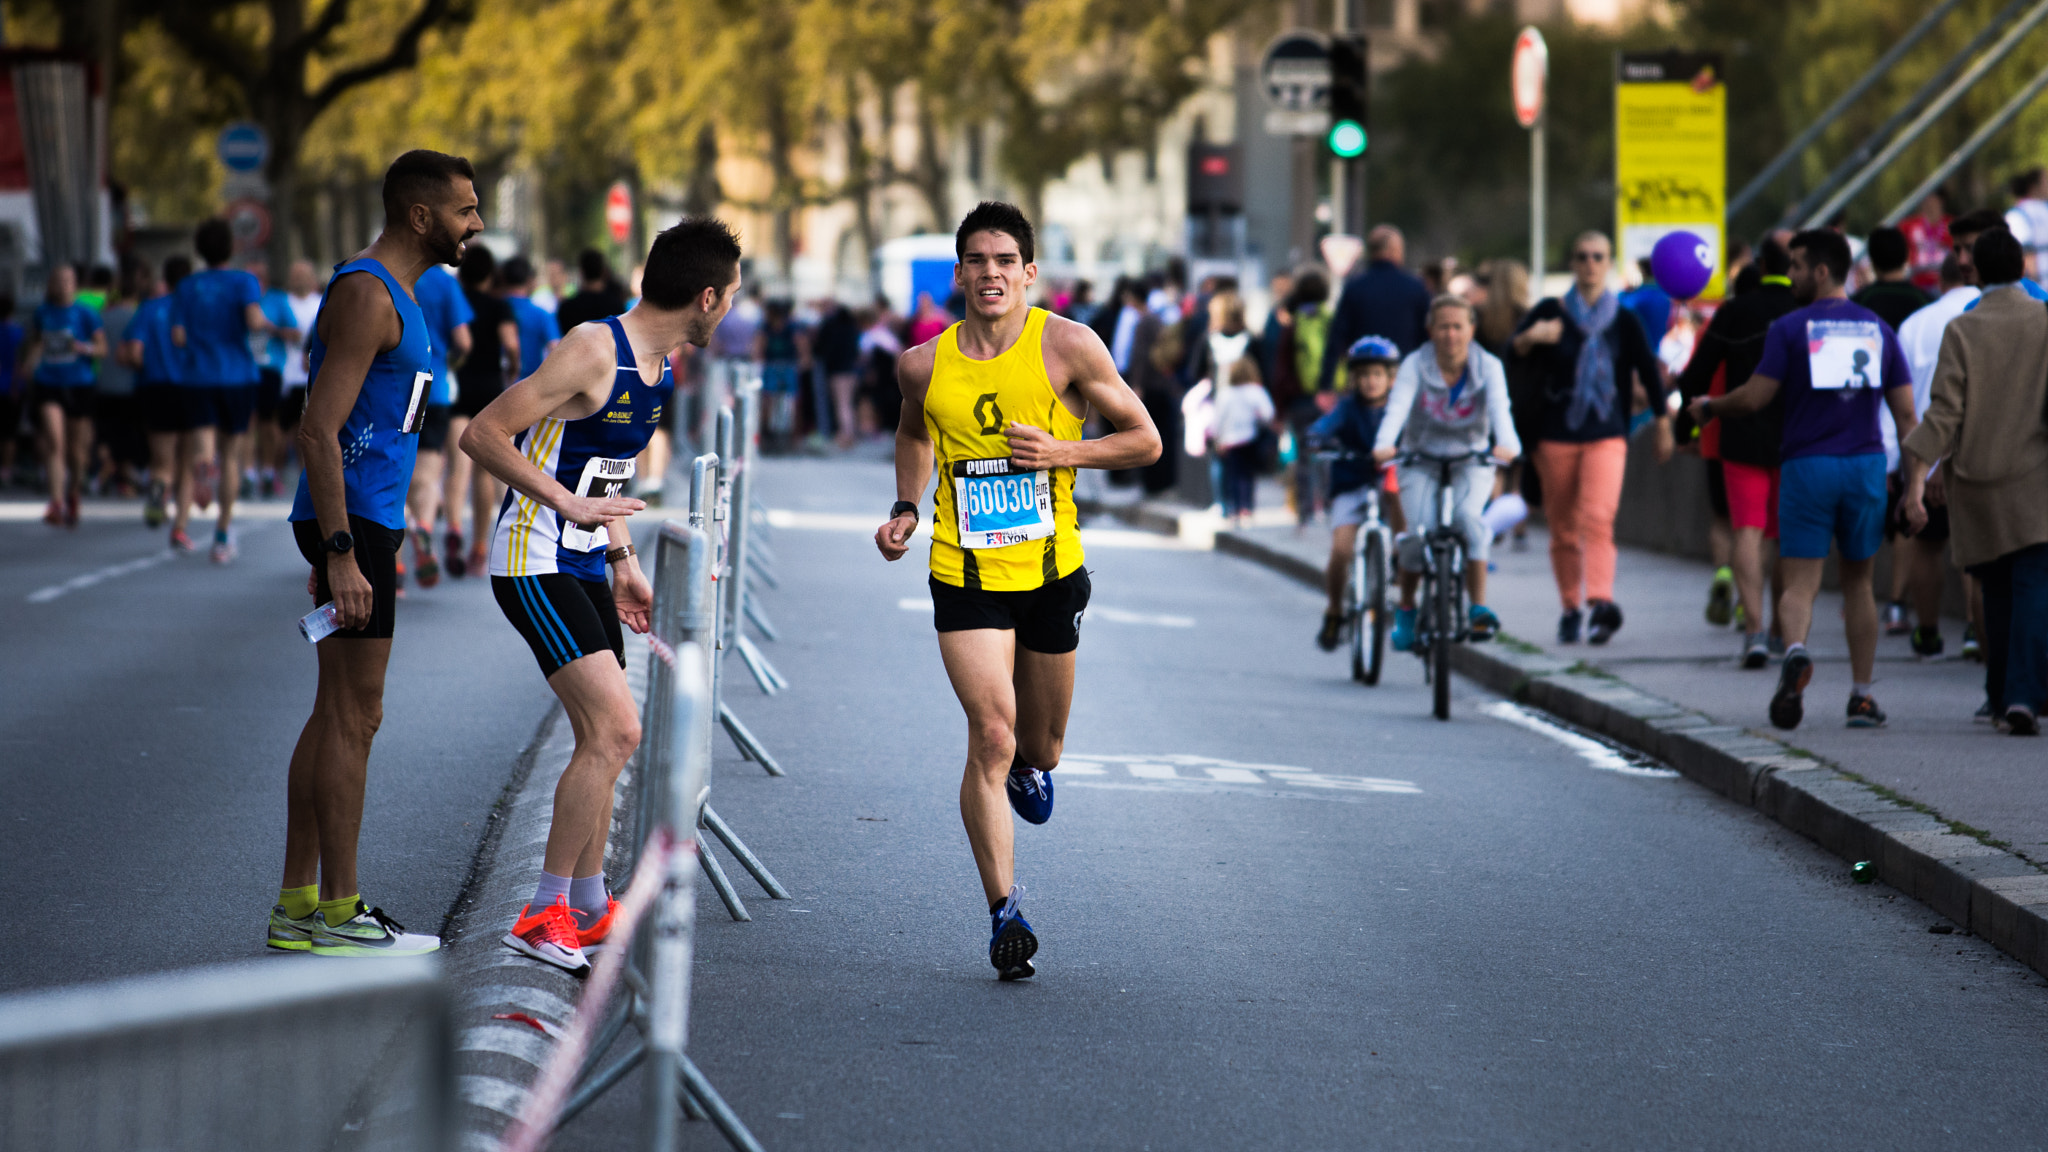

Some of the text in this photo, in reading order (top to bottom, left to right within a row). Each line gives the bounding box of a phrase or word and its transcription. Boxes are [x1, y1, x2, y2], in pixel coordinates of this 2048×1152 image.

[600, 460, 627, 474] PUMA
[966, 459, 1008, 475] PUMA
[1036, 483, 1048, 496] ELITE
[968, 478, 1034, 516] 60030
[1040, 498, 1047, 510] H
[1002, 533, 1028, 544] LYON
